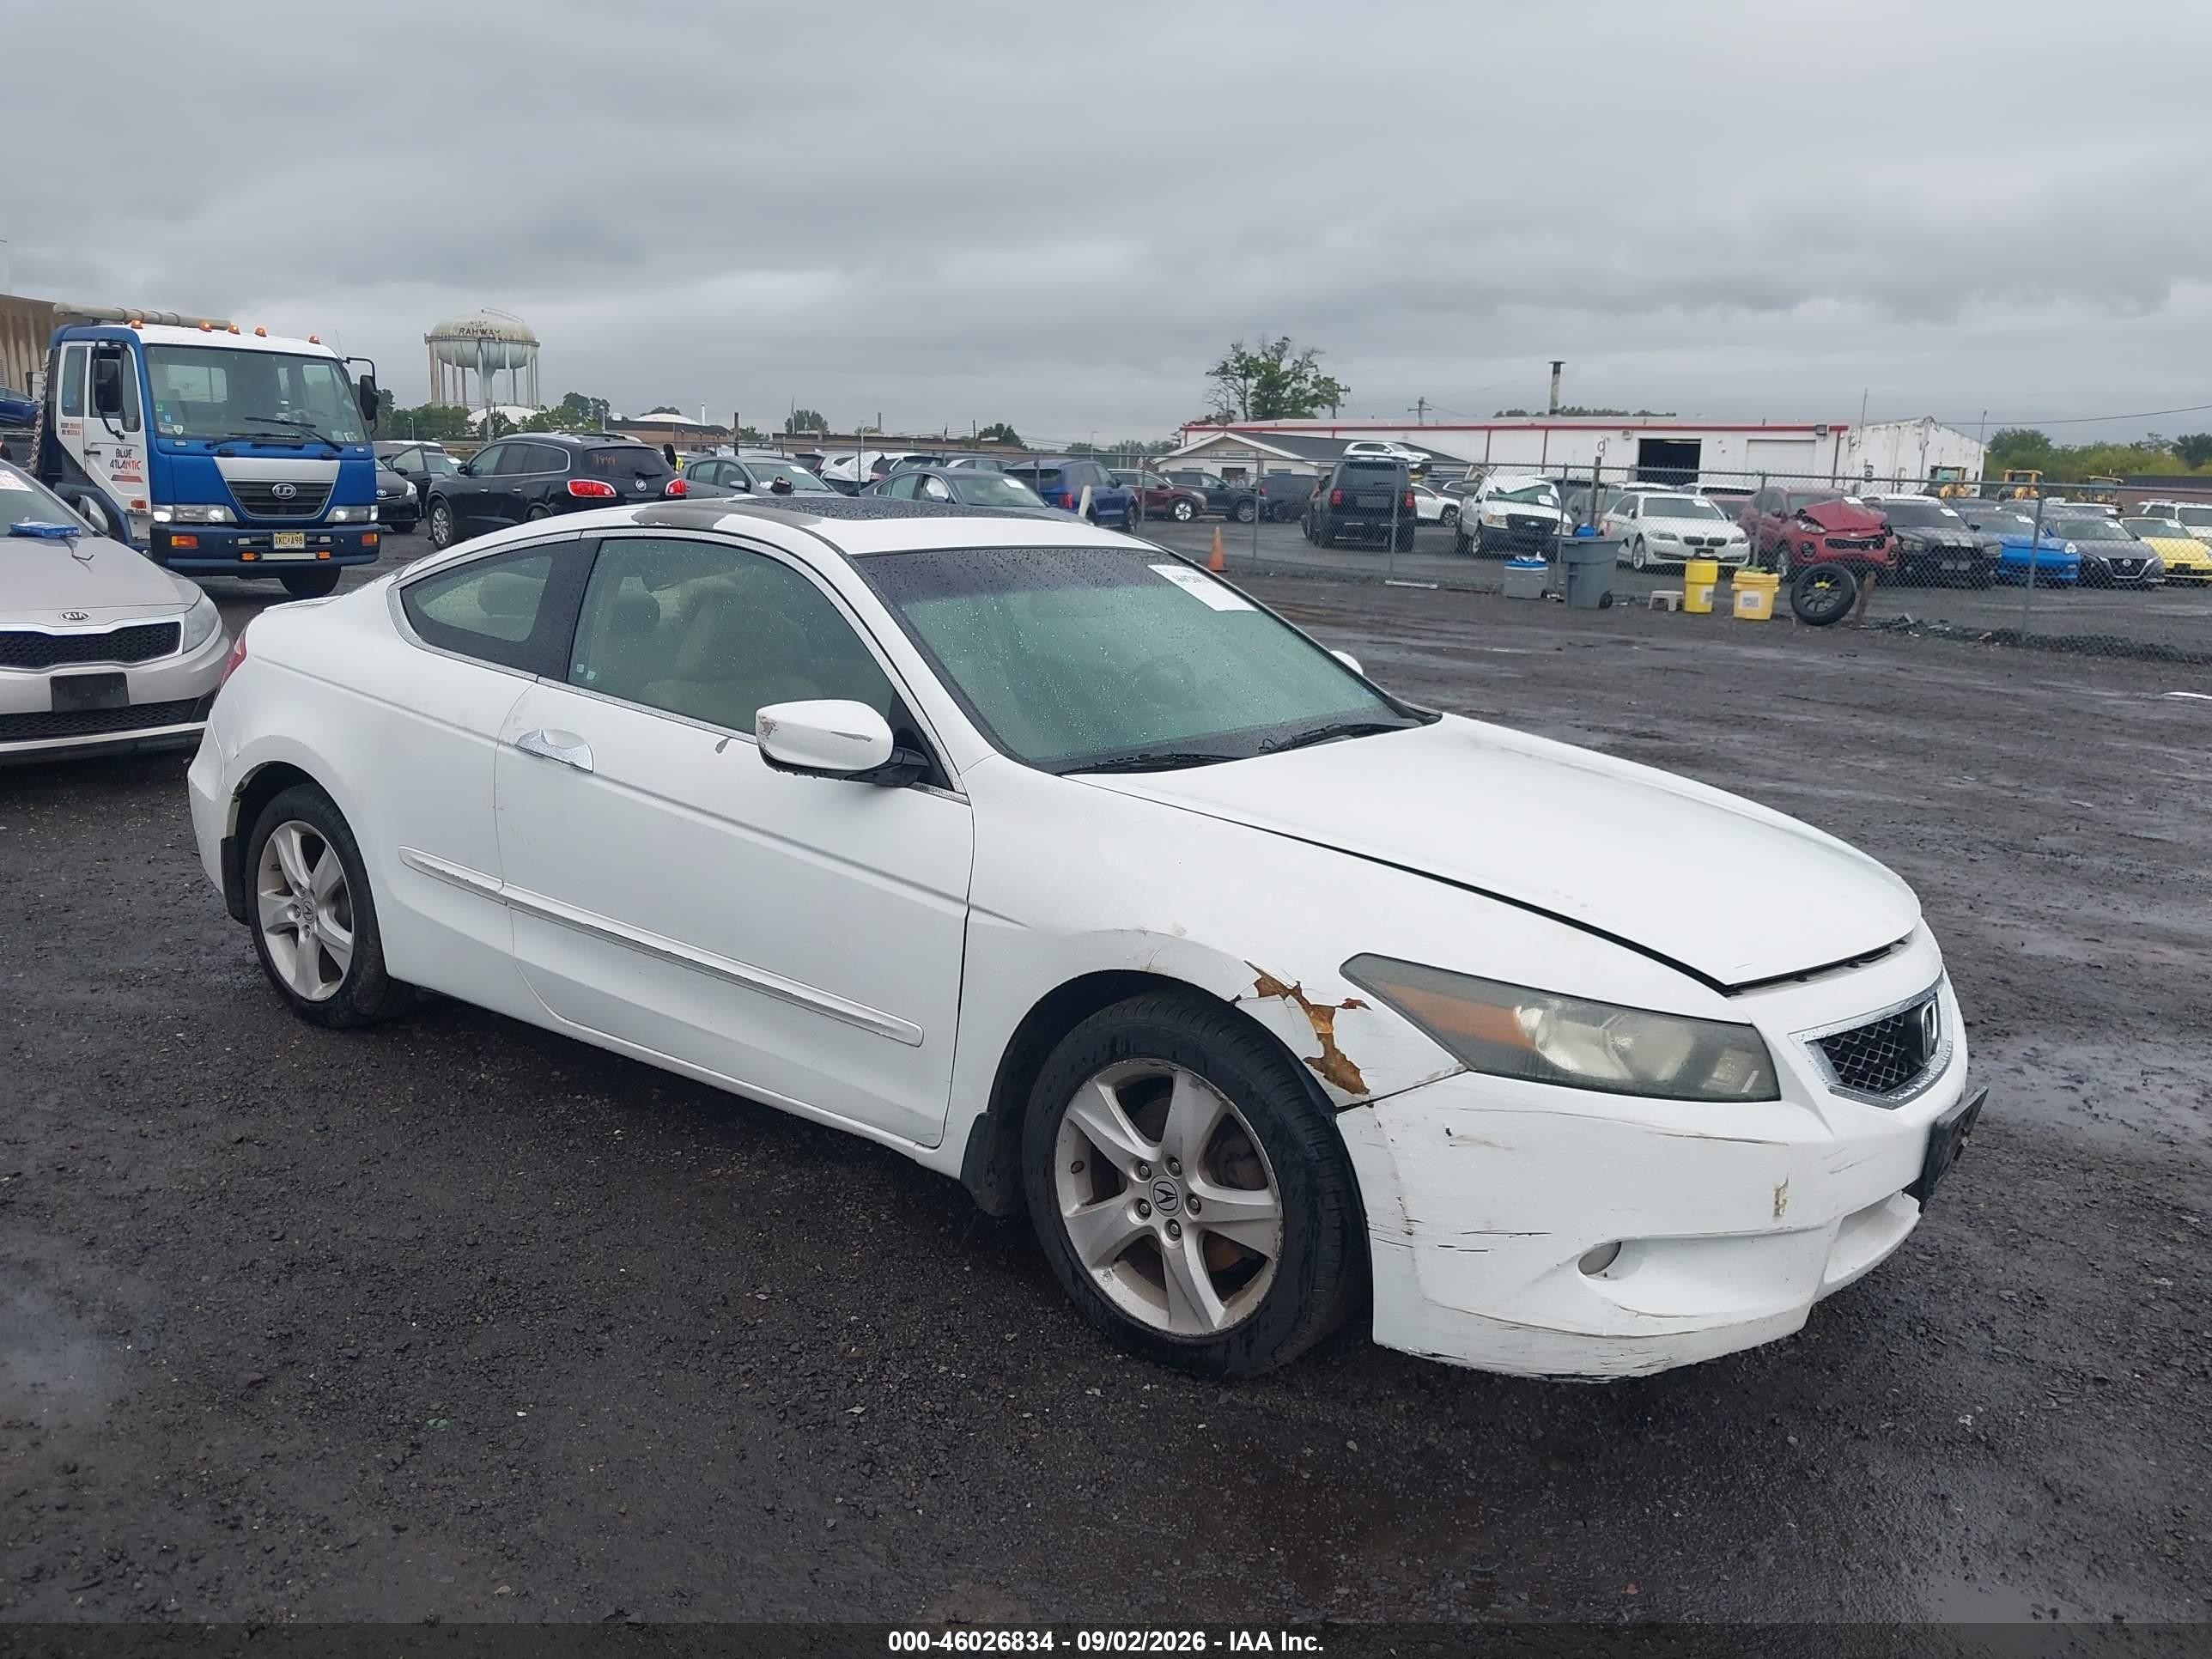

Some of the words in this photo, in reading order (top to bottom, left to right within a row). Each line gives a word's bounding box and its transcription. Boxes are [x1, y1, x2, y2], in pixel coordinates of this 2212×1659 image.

[459, 327, 501, 336] RAHWAY
[115, 448, 132, 458] BLUE
[110, 459, 141, 470] ATLANTIC
[62, 611, 88, 620] KIA
